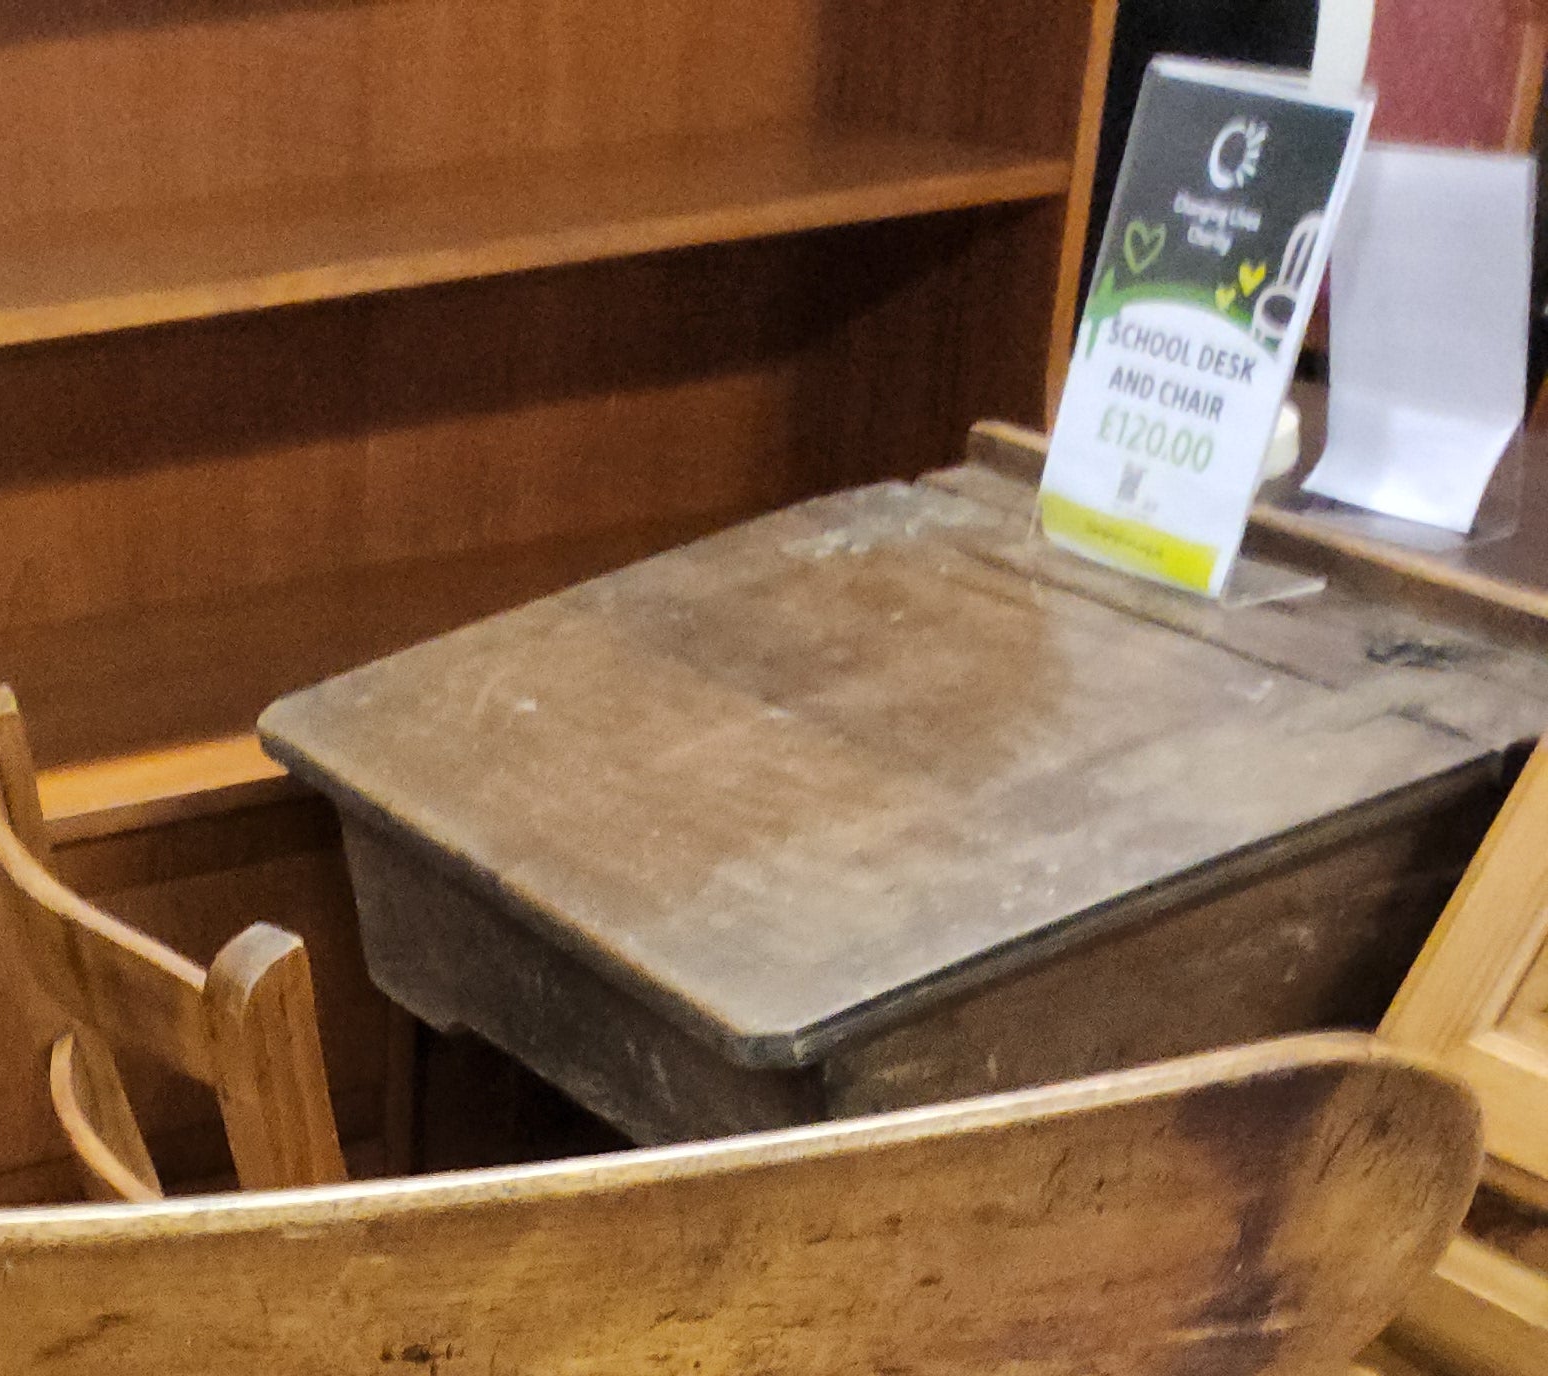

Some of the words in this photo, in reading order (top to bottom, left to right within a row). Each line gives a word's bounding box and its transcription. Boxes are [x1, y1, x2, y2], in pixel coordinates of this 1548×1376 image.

[1108, 315, 1190, 367] SCHOOL
[1196, 344, 1256, 383] DESK
[1108, 365, 1155, 400] AND
[1158, 380, 1225, 423] CHAIR
[1097, 403, 1215, 474] £120.00
